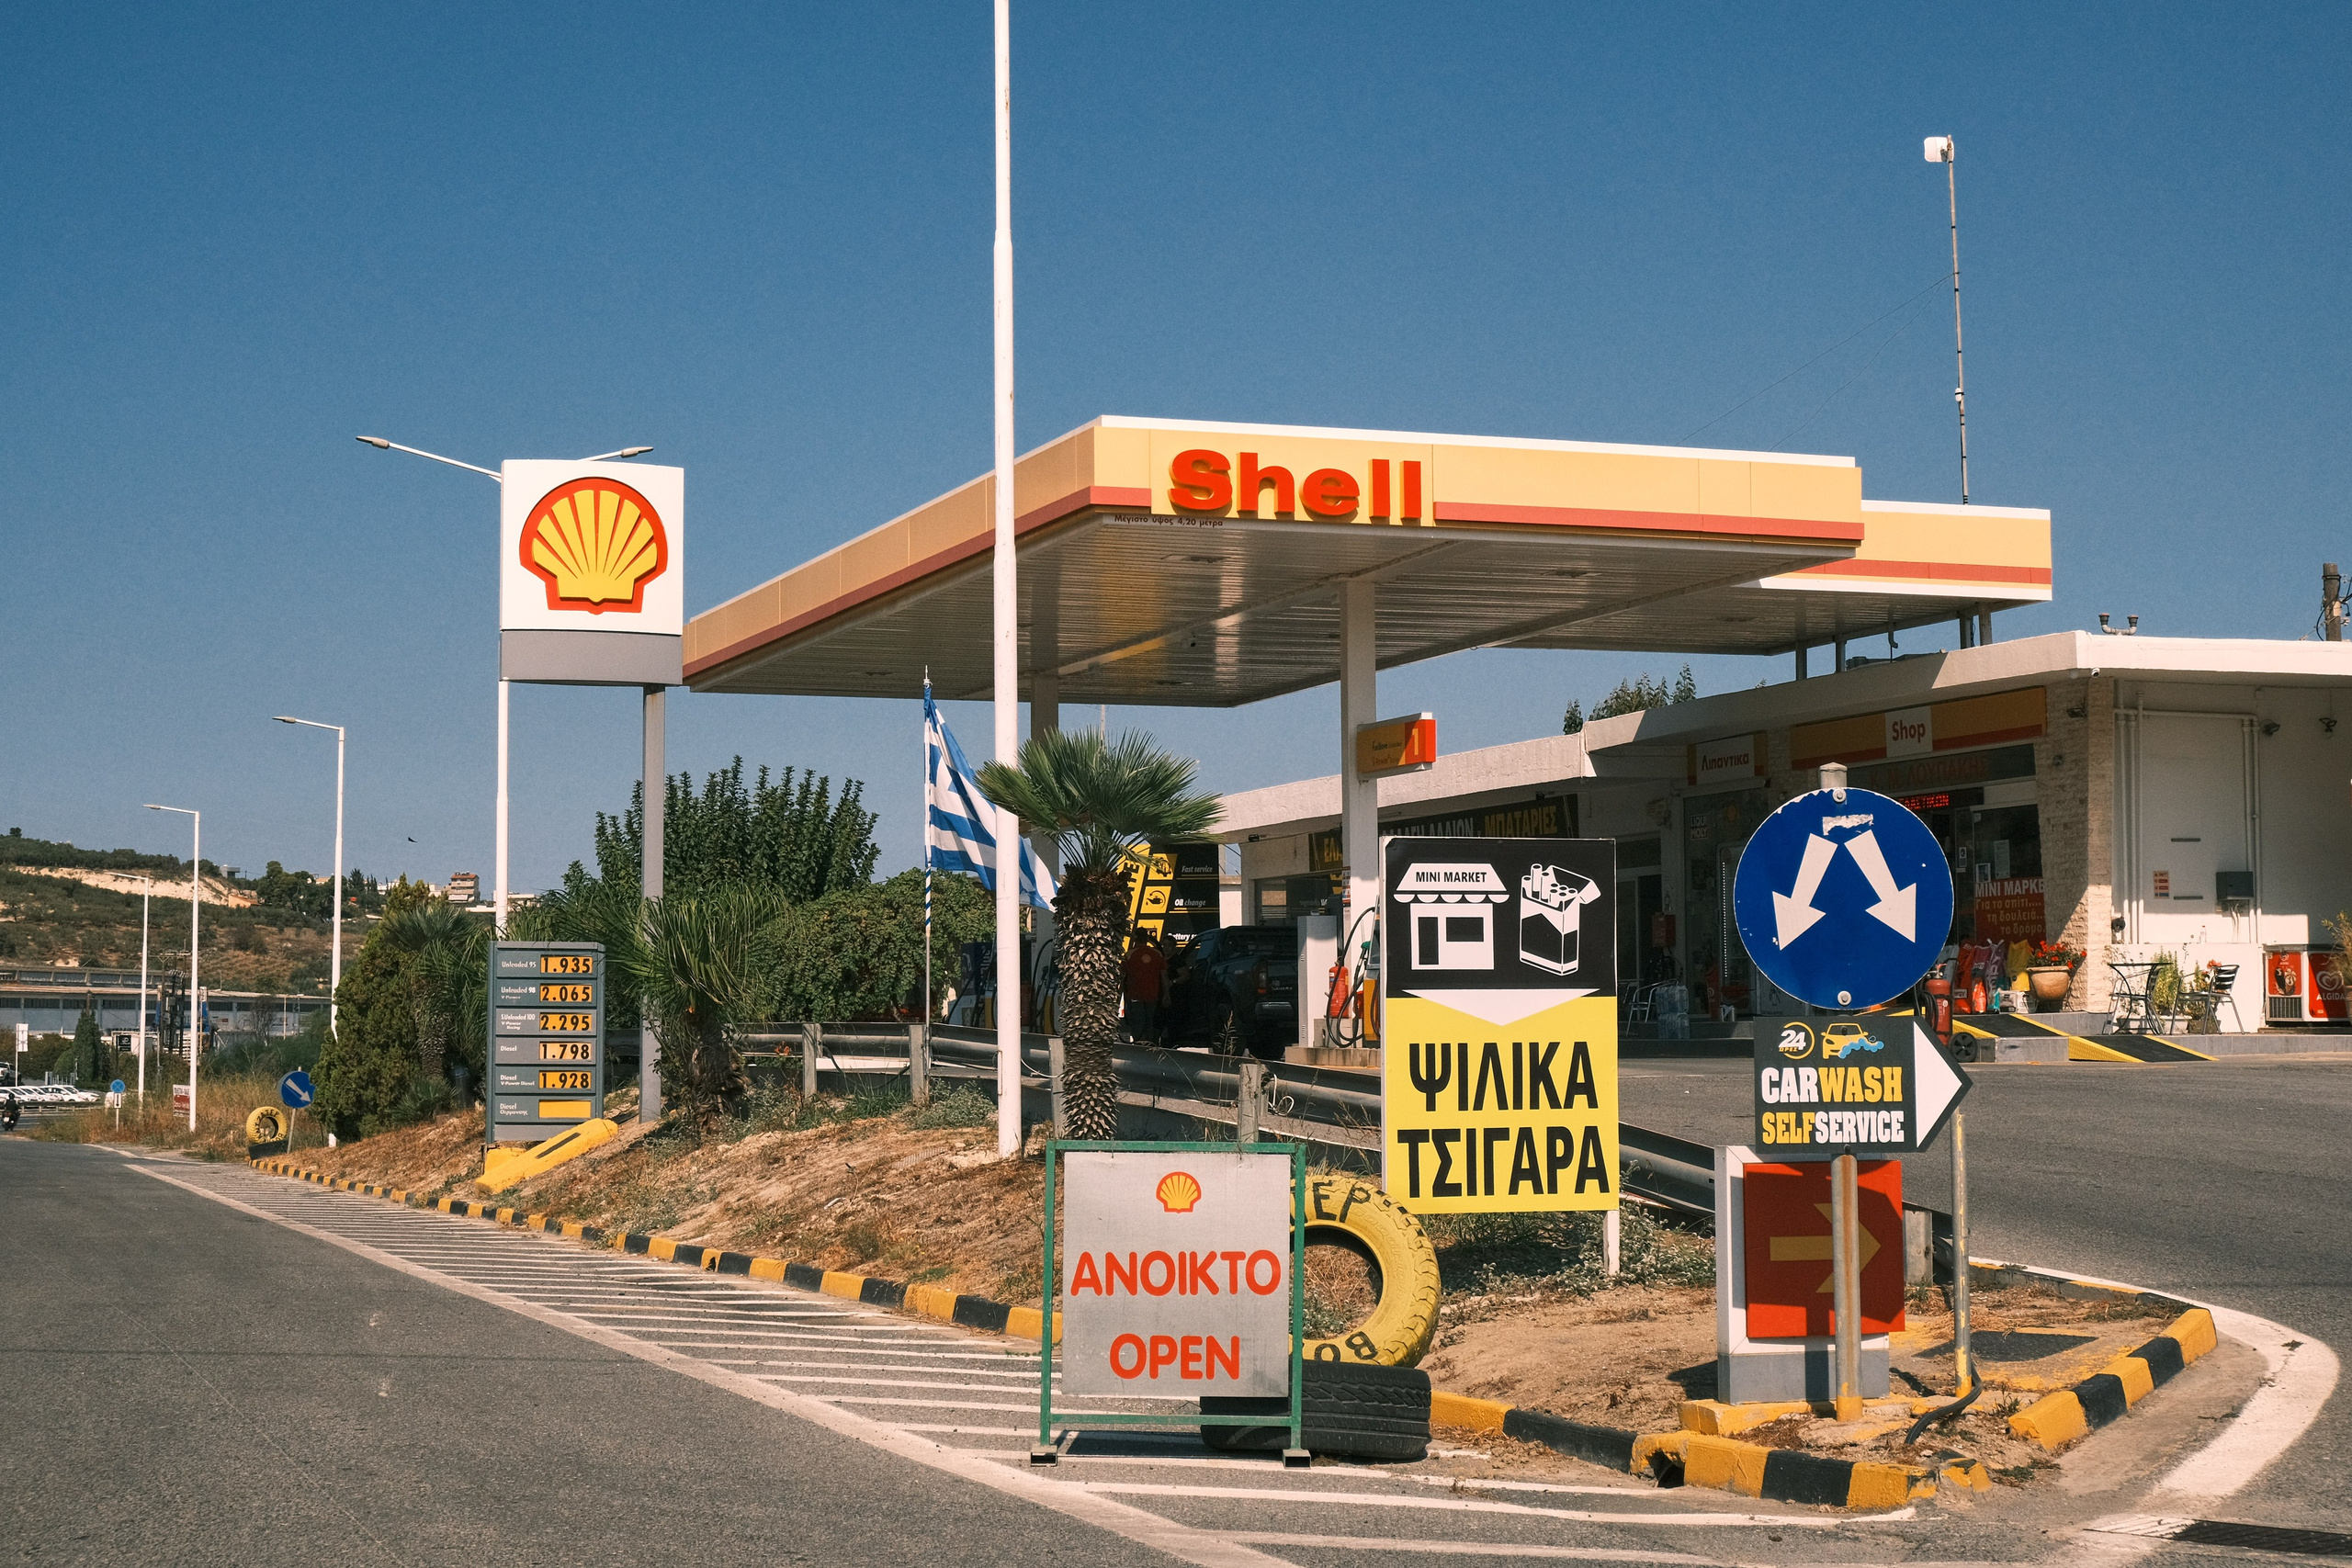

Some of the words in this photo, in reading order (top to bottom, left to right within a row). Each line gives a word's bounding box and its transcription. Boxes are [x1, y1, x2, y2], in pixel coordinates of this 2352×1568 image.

[1169, 448, 1421, 520] Shell
[1114, 514, 1148, 525] Μέγιστο
[1151, 515, 1174, 525] ύψος
[1177, 518, 1196, 526] 4,20
[1199, 518, 1223, 528] μέτρα
[1892, 715, 1926, 743] Shop
[1412, 728, 1419, 756] 1
[1485, 805, 1558, 837] ΜΠΑΤΑΡΙΕΣ
[1193, 864, 1213, 873] service
[1415, 871, 1441, 883] MINI
[1443, 870, 1487, 884] MARKET
[1174, 898, 1184, 907] Oil
[1184, 898, 1206, 908] change
[1975, 898, 1990, 910] Για
[1992, 899, 2003, 909] το
[1986, 914, 1997, 925] τη
[2000, 926, 2011, 935] το
[543, 957, 591, 974] 1.935
[542, 986, 590, 1001] 2.065
[2316, 992, 2346, 1001] ALGIDA
[541, 1014, 590, 1031] 2.295
[1778, 1029, 1807, 1051] 24
[542, 1043, 590, 1060] 1.798
[542, 1073, 589, 1089] 1.928
[1408, 1041, 1600, 1112] ΨΙΛΙΚΑ
[1396, 1125, 1611, 1199] ΤΣΙΓΑΡΑ
[1069, 1249, 1282, 1297] ΑΝΟΙΚΤΟ
[1109, 1333, 1240, 1380] OPEN
